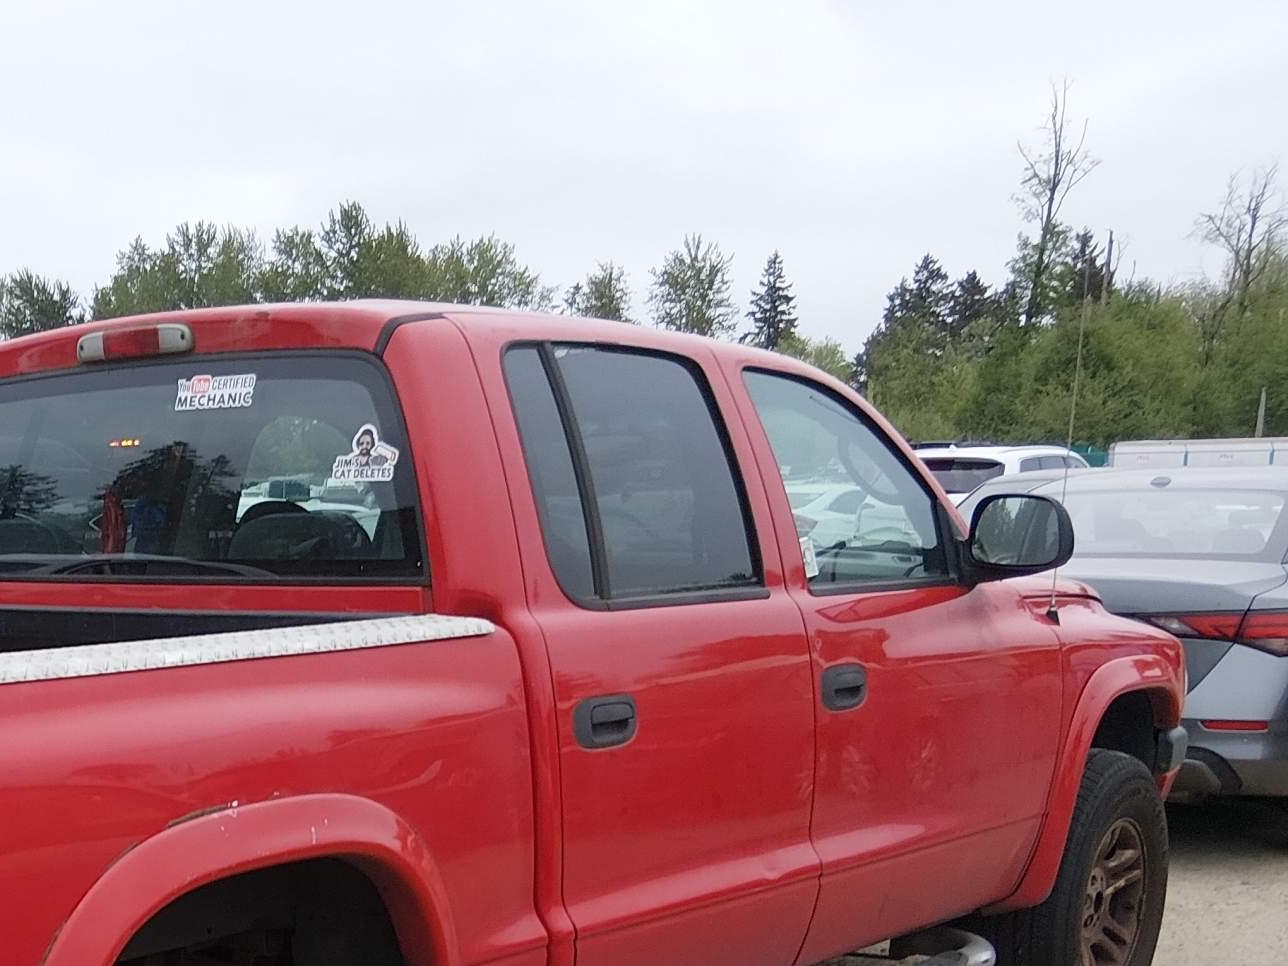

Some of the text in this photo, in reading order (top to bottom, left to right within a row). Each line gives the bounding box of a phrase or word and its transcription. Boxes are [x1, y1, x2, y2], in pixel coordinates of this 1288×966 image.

[212, 375, 255, 390] CERTIFIED
[176, 391, 253, 409] MECHANIC
[334, 468, 392, 480] CAT DELETES
